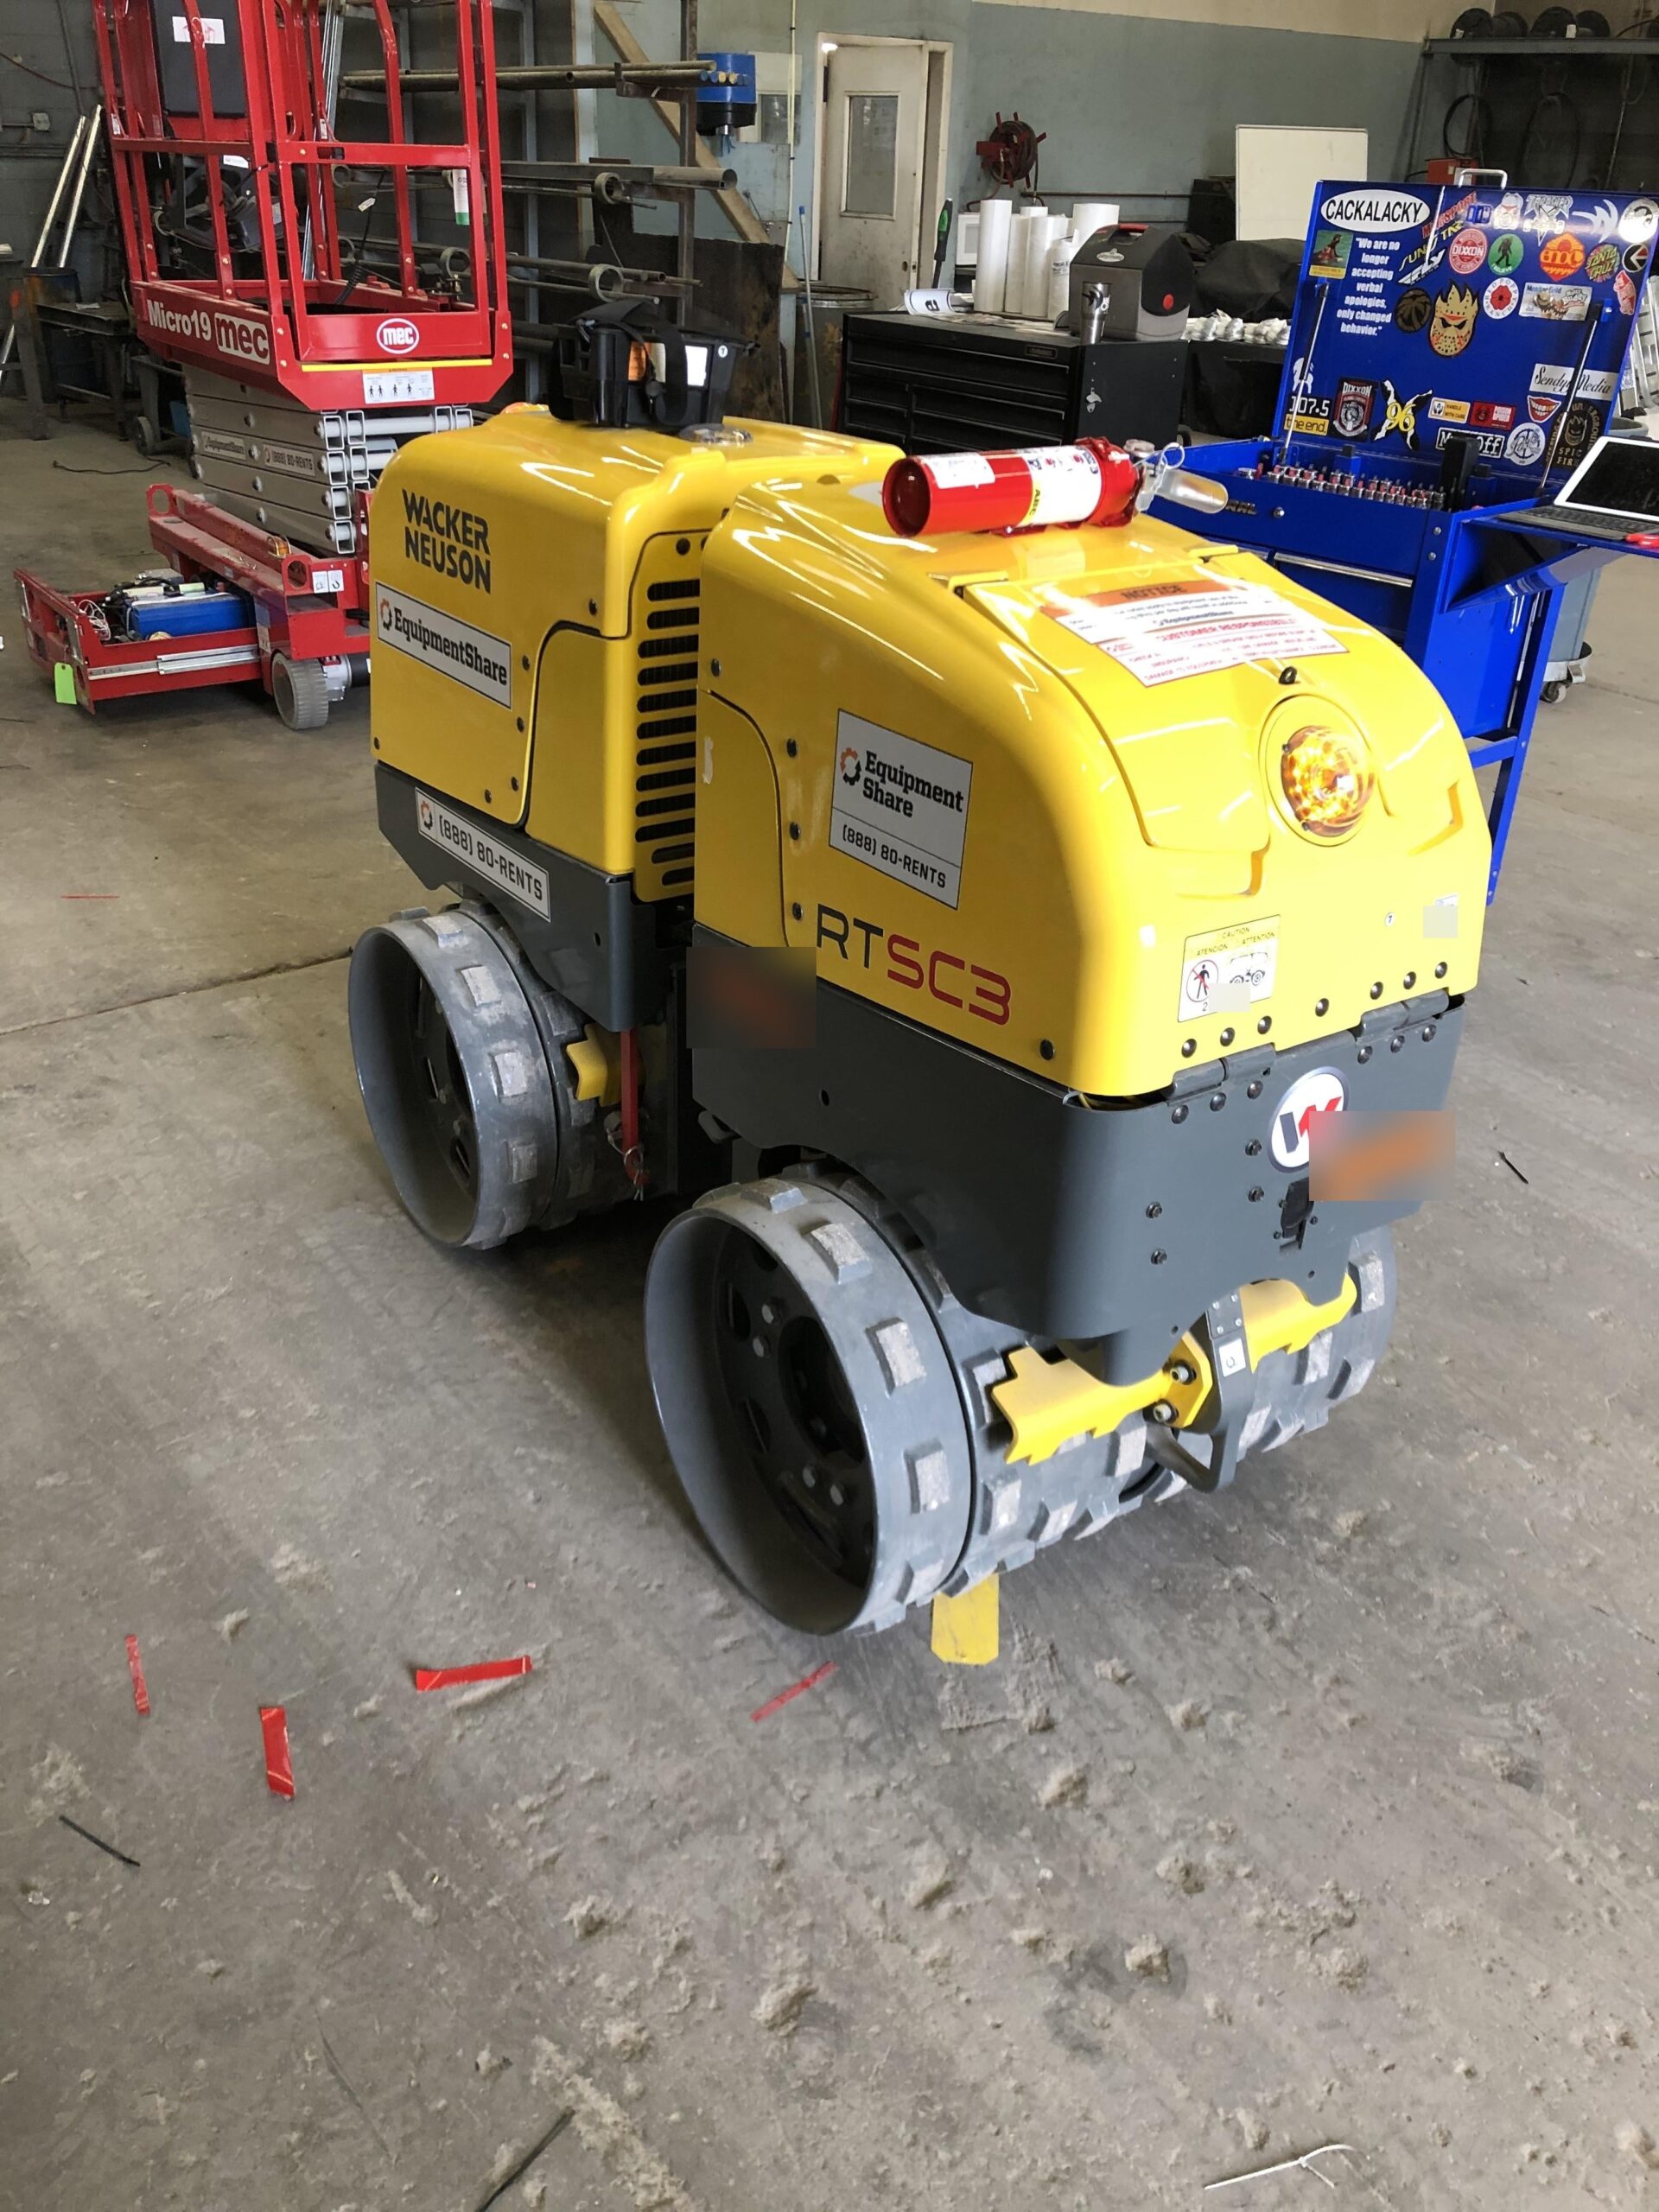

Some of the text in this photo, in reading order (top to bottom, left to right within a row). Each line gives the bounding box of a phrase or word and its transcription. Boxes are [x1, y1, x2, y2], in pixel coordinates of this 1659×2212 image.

[1325, 199, 1423, 223] CACKALACKY
[1373, 240, 1388, 250] are
[1389, 241, 1401, 251] no
[1452, 245, 1484, 257] DIXXON
[1361, 252, 1390, 265] longer
[1585, 246, 1618, 270] SANTA
[1351, 267, 1394, 281] accepting
[1590, 260, 1616, 280] CRUZ
[1356, 282, 1383, 293] verbal
[1344, 295, 1387, 309] apologies,
[1336, 308, 1392, 323] only changed
[147, 299, 270, 359] Micro19 mec
[382, 327, 415, 346] mec
[1342, 381, 1372, 397] DIXXON
[1289, 396, 1331, 417] 107.5
[401, 487, 491, 555] WACKER
[404, 525, 492, 595] NEUSON
[393, 606, 508, 687] EquipmentShare
[863, 749, 965, 813] Equipment
[862, 779, 915, 818] Share
[439, 814, 543, 901] (888) 80-RENTS
[842, 823, 947, 890] (888) 80-RENTS
[1222, 926, 1250, 939] CAUTION
[1242, 931, 1275, 945] ATTENTION
[817, 902, 1012, 1027] RTSC3
